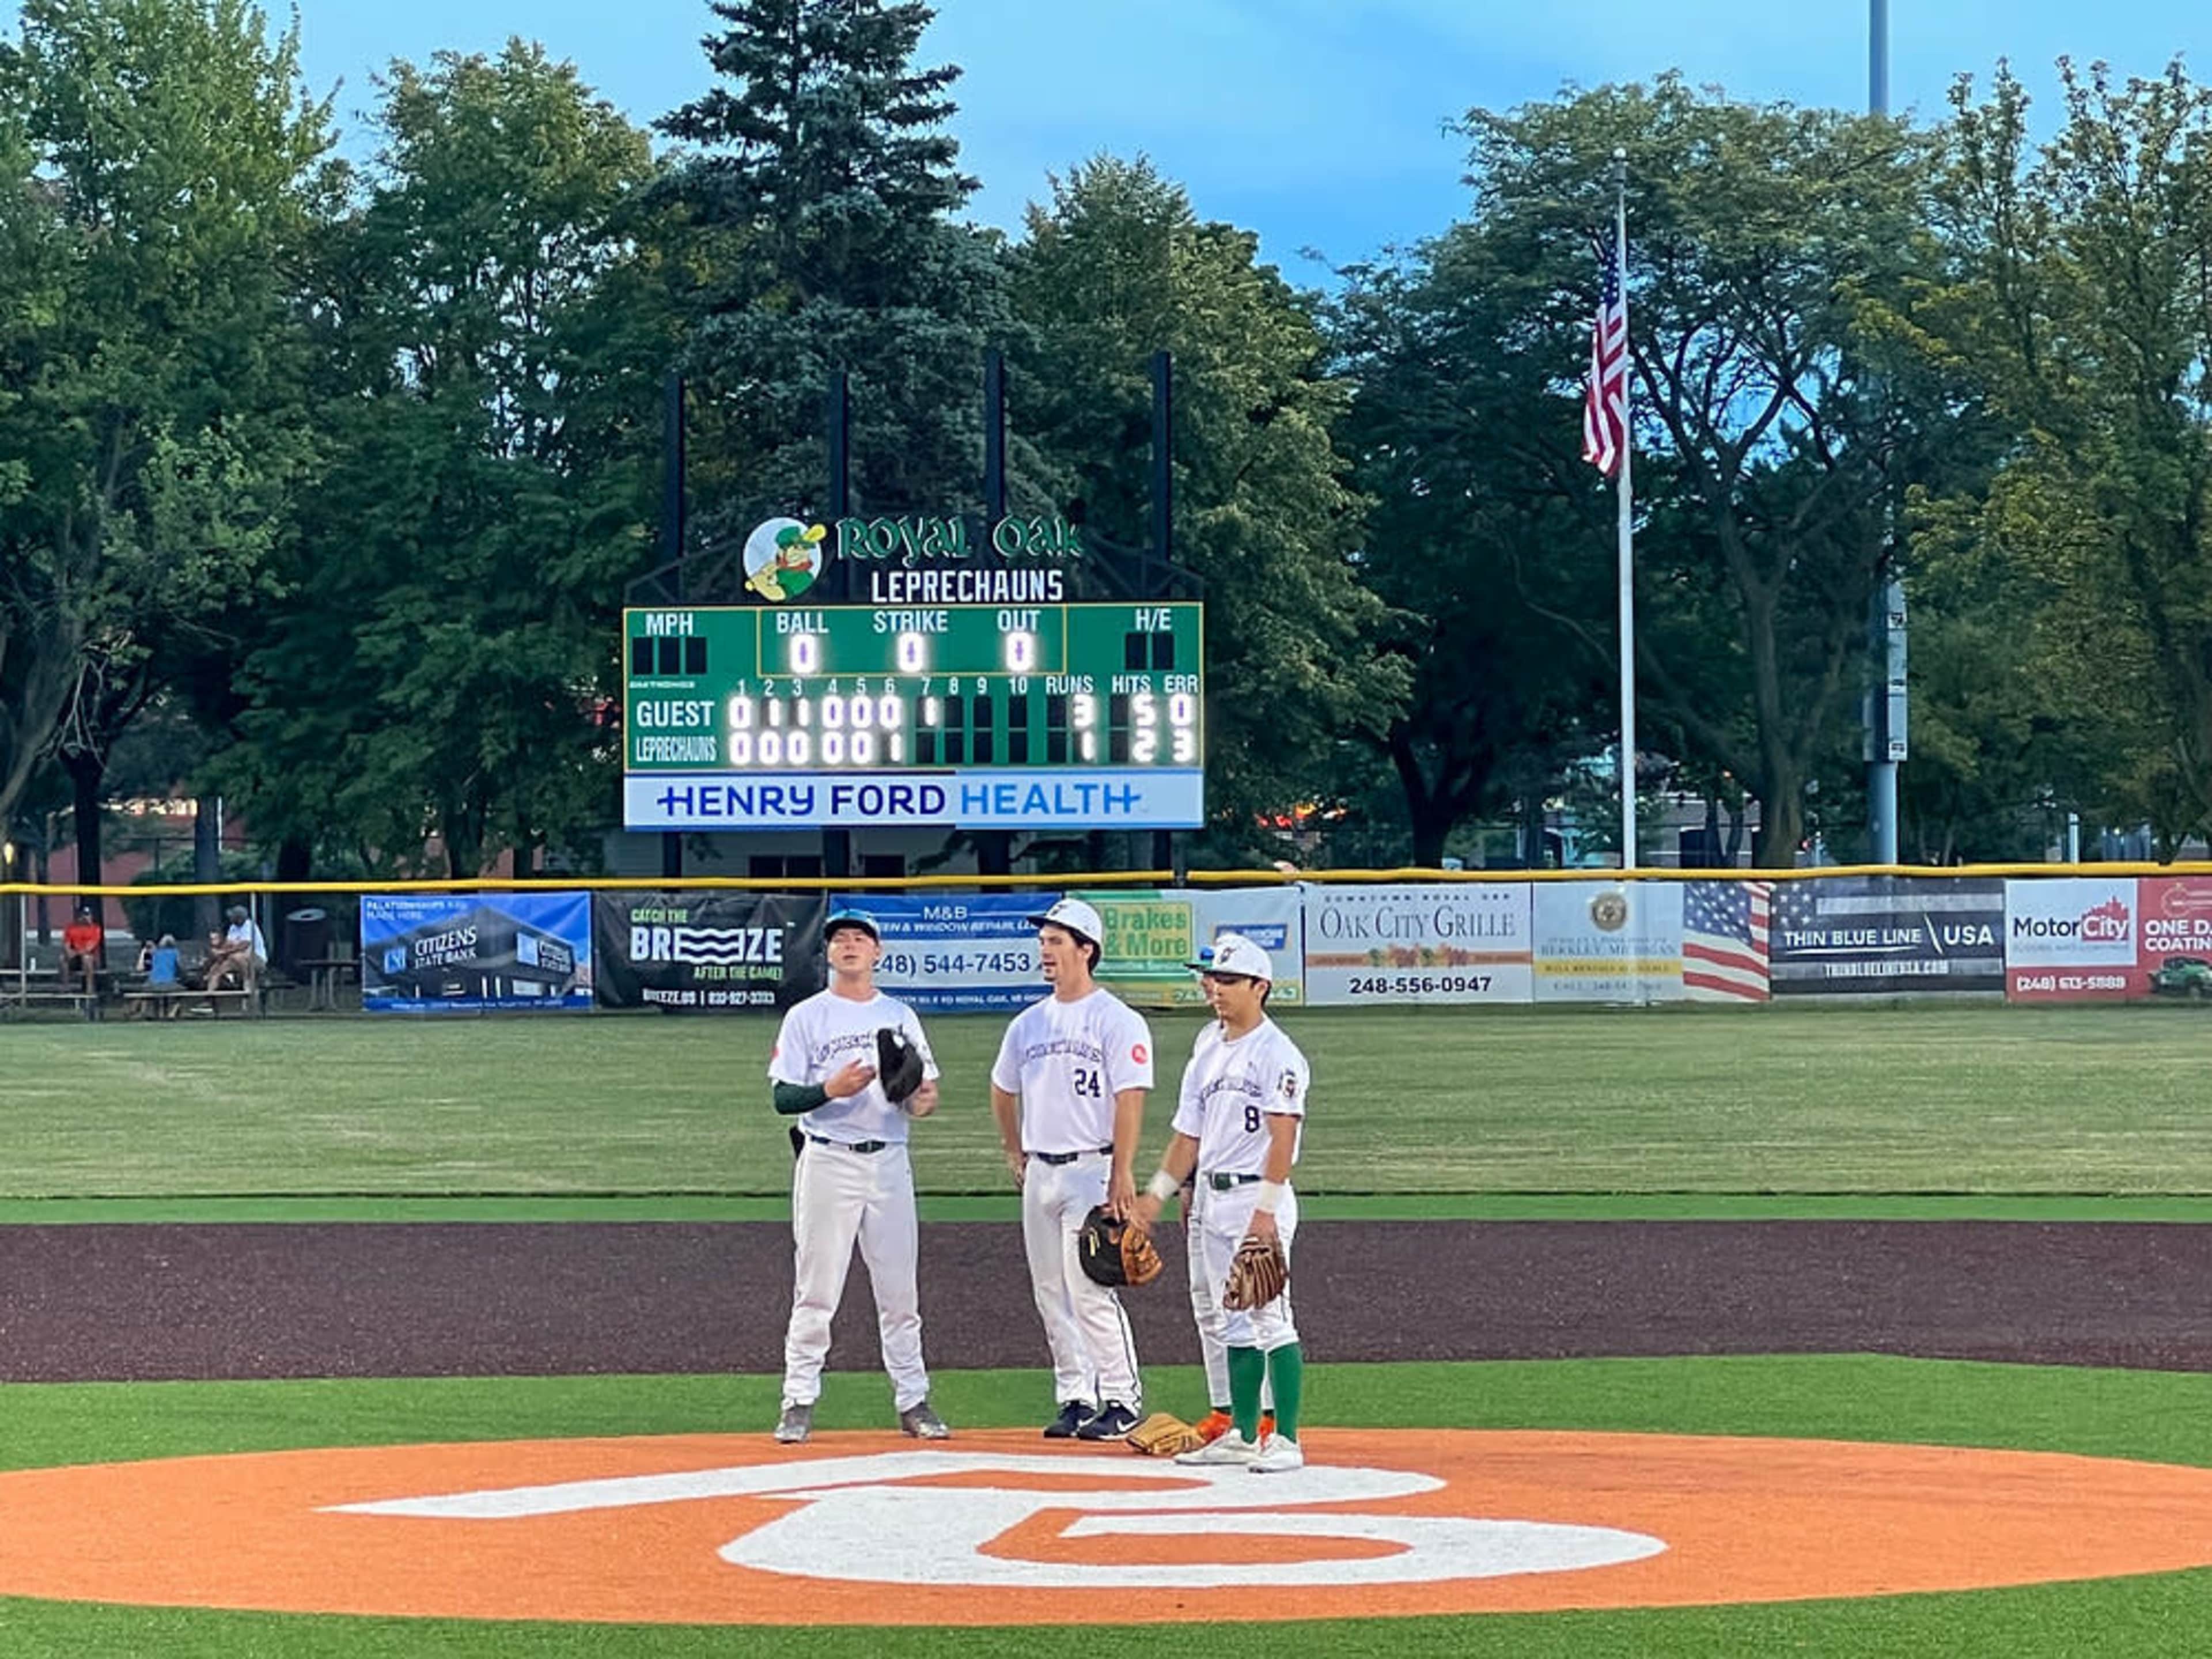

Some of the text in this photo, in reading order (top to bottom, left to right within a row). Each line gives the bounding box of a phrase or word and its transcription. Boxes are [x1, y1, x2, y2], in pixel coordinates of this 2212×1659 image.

[872, 570, 1063, 603] LEPRECHAUNS
[646, 613, 694, 635] MPH
[776, 610, 1041, 633] BALL STRIKE OUT
[1135, 608, 1173, 632] H/E
[790, 632, 1034, 673] 0 0 0
[738, 675, 1198, 695] 1 2 3 4 5 6 7 8 9 10 RUNS HITS ERR
[637, 700, 715, 727] GUEST
[730, 692, 1194, 729] 0 1 1 0 0 0 1 3 5 0
[636, 736, 717, 762] LEPRECHAUNS
[730, 728, 1194, 766] 0 0 0 0 0 1 1 2 3
[657, 783, 1142, 816] HENRY FORD HEALTH
[923, 906, 968, 921] M&B
[1104, 907, 1187, 930] Brakes
[1785, 925, 1994, 947] THIN BLUE LINE USA
[2013, 915, 2127, 939] MotorCity
[2145, 919, 2190, 935] ONE
[415, 925, 477, 957] CITIZENS
[630, 926, 783, 965] BREEZE
[1104, 933, 1187, 956] & More
[415, 953, 443, 969] STATE
[445, 946, 477, 963] BANK
[924, 953, 1031, 974] 544-7453
[1349, 976, 1492, 995] 248-556-0947
[1075, 1069, 1101, 1098] 24
[1245, 1105, 1260, 1133] 8
